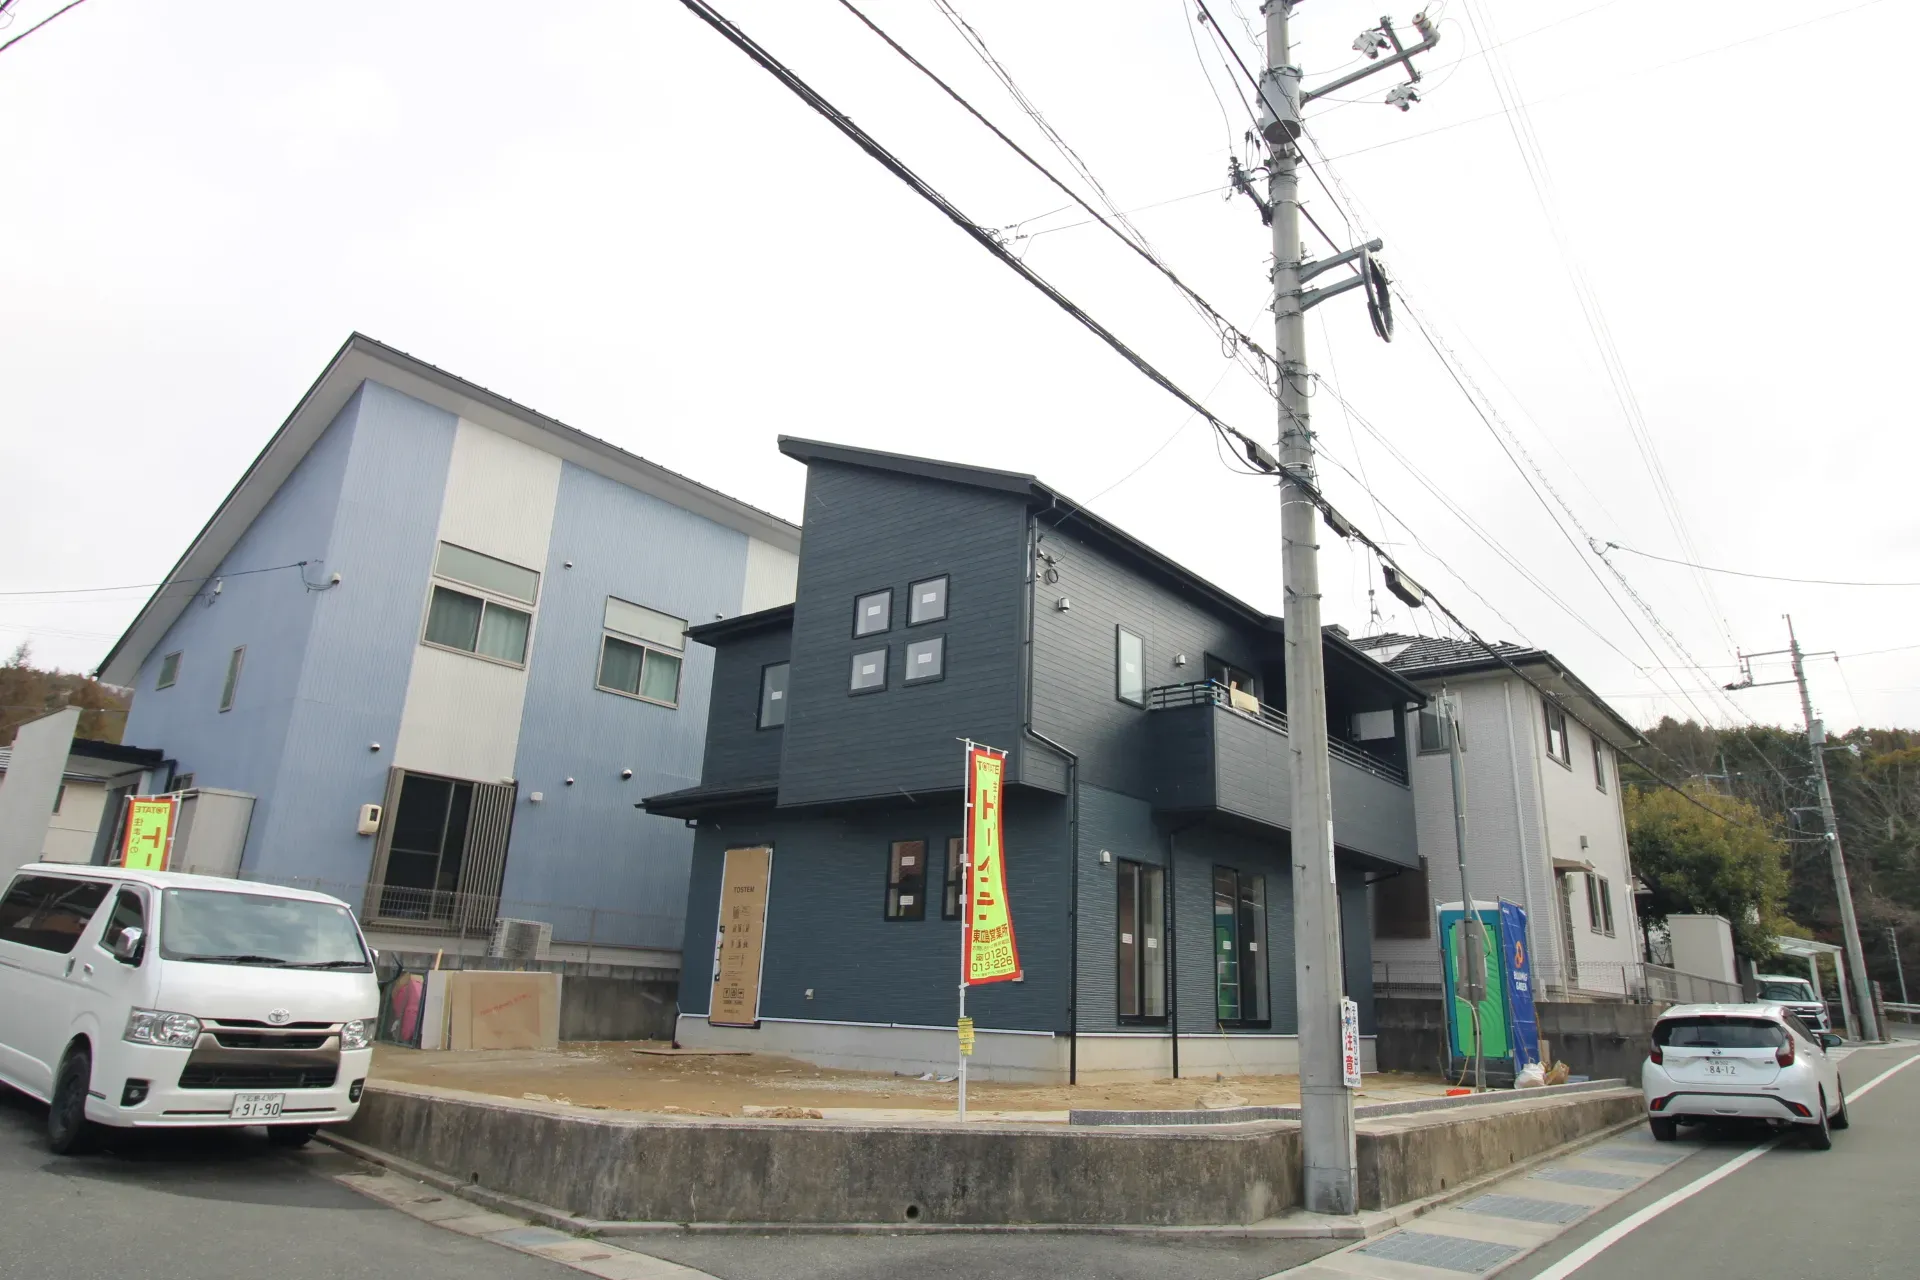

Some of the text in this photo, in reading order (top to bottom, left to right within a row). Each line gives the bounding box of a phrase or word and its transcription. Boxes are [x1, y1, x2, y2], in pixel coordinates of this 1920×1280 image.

[733, 886, 755, 894] TOSTEM
[984, 946, 1008, 961] 0120
[972, 956, 1013, 972] 013-226
[1345, 1032, 1355, 1076] 注意
[1709, 1065, 1736, 1075] 84-12
[242, 1103, 279, 1116] 91-90
